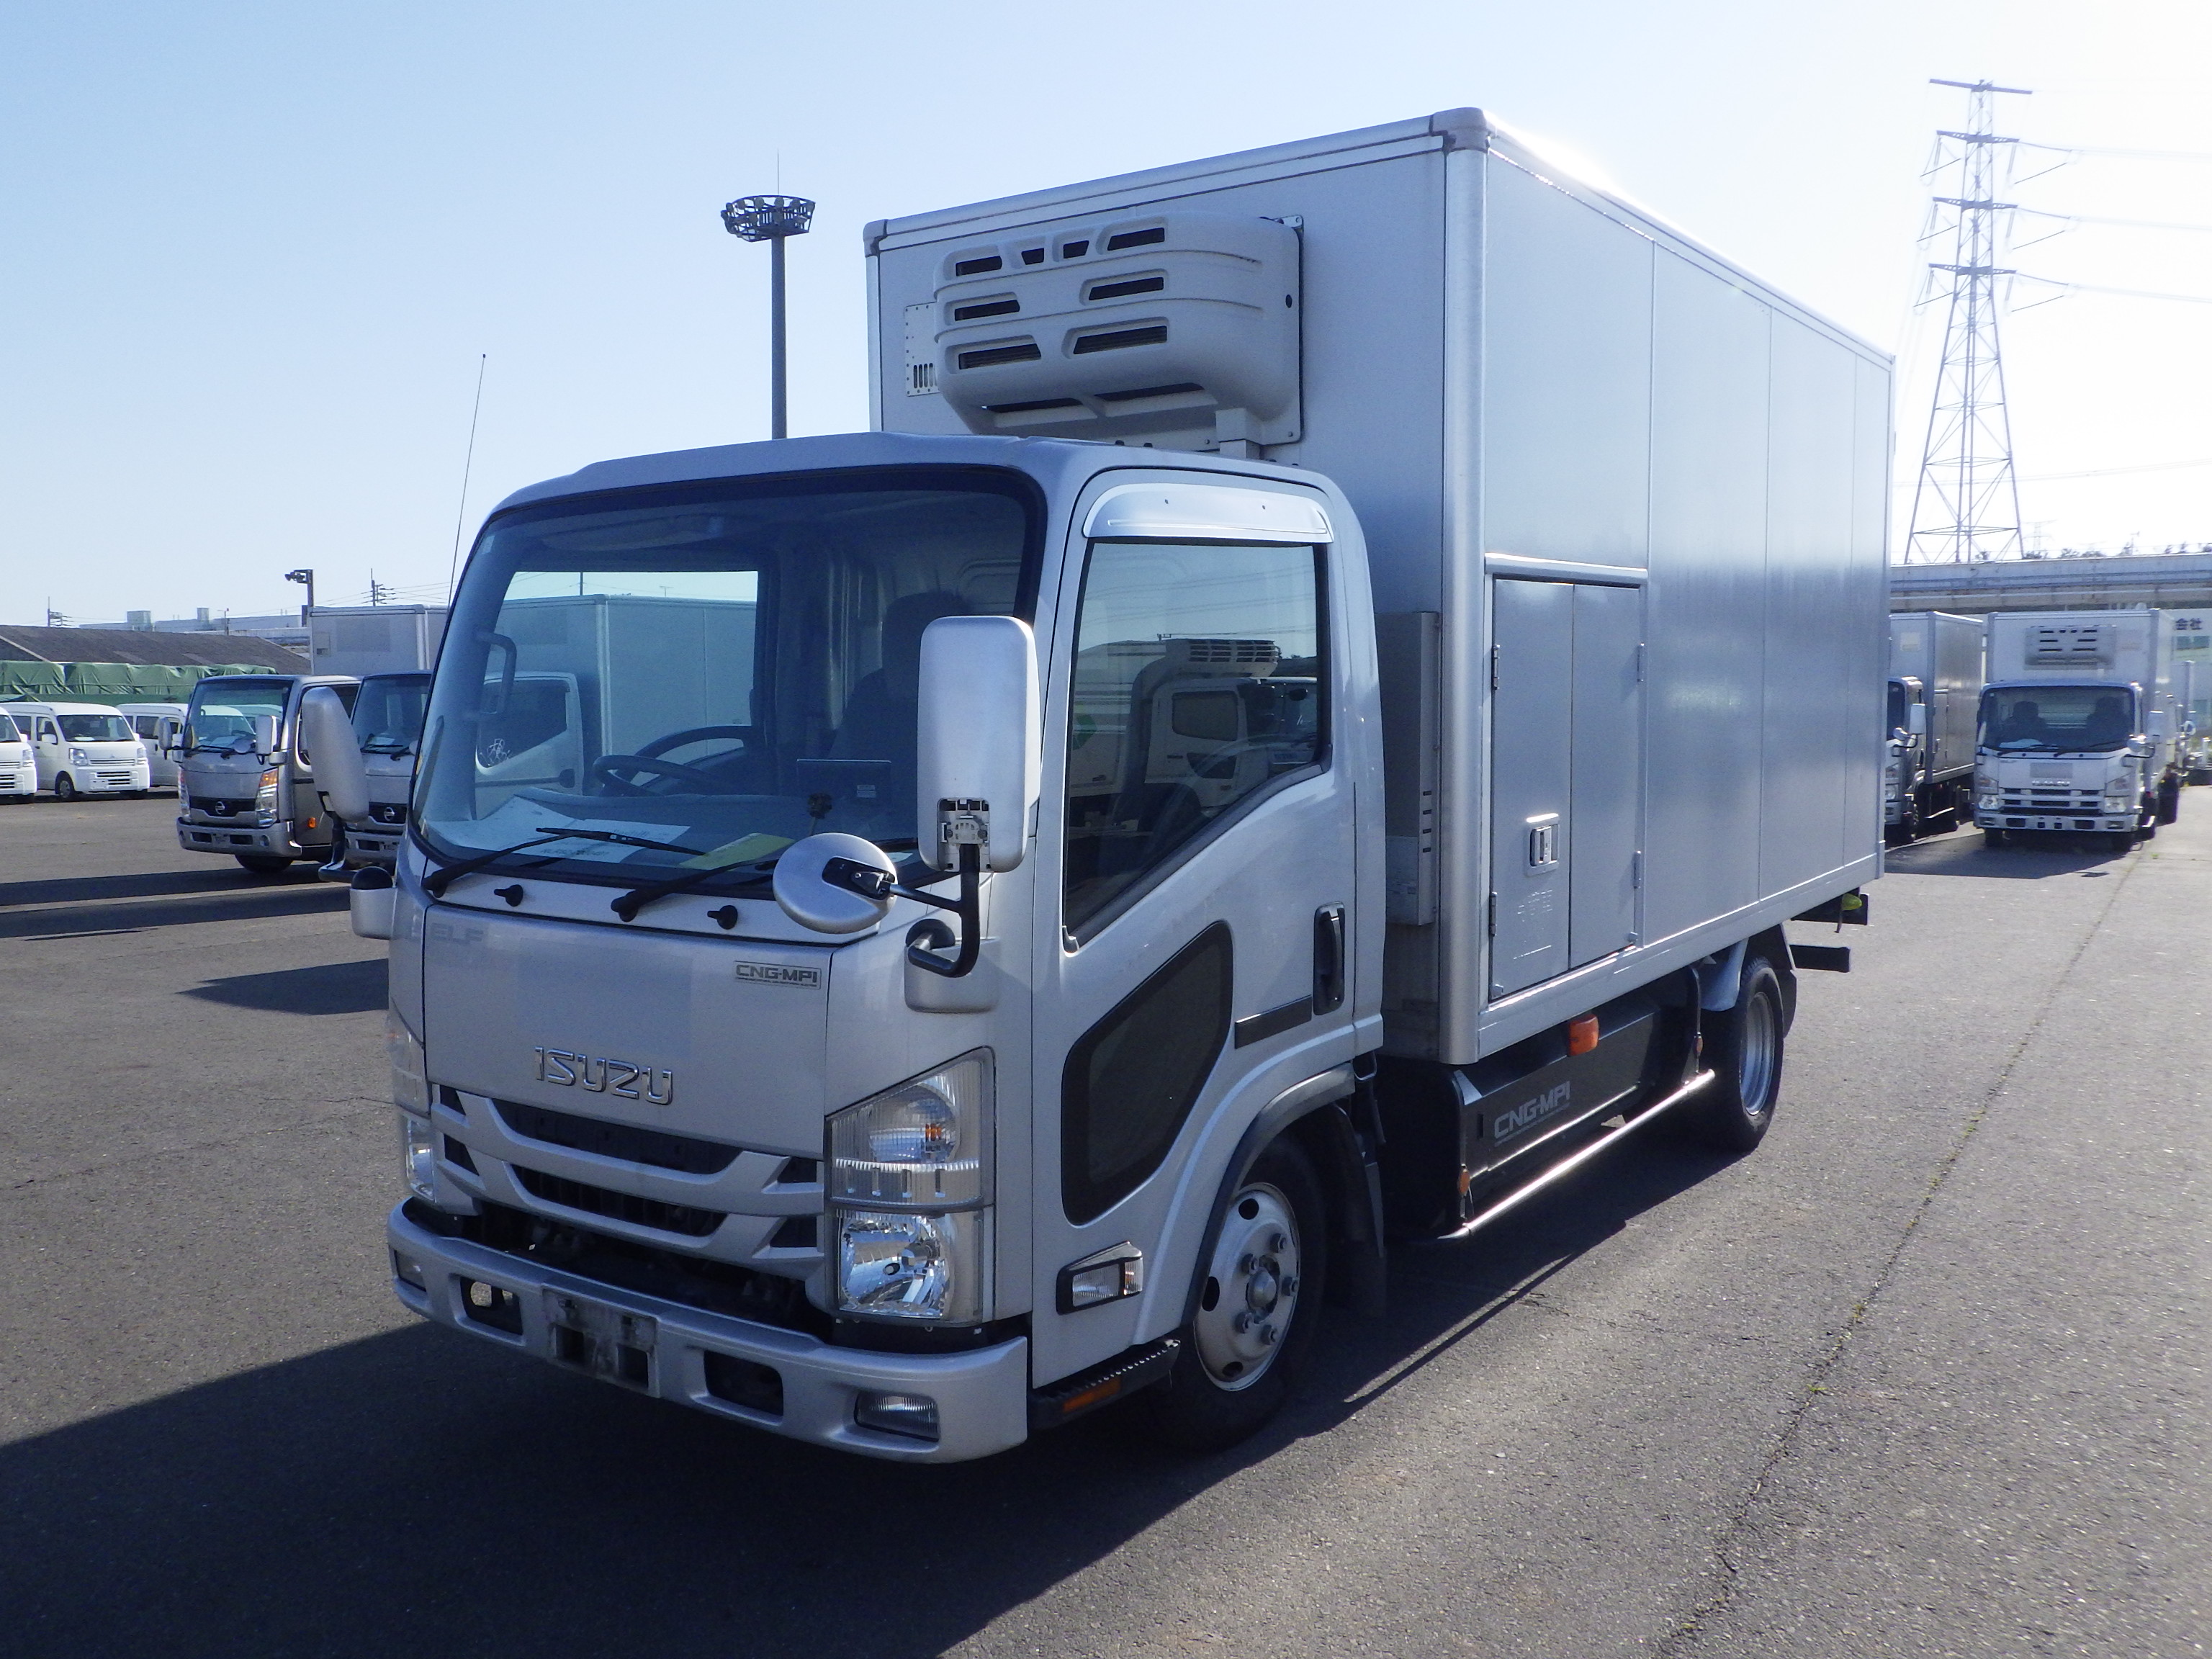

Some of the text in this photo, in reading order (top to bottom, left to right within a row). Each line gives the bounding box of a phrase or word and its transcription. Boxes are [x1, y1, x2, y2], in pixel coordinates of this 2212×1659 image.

[2175, 618, 2203, 631] 会社
[736, 964, 817, 983] CNG-MPI
[534, 1046, 673, 1105] ISUZU
[1494, 1081, 1570, 1138] CNG-MPI
